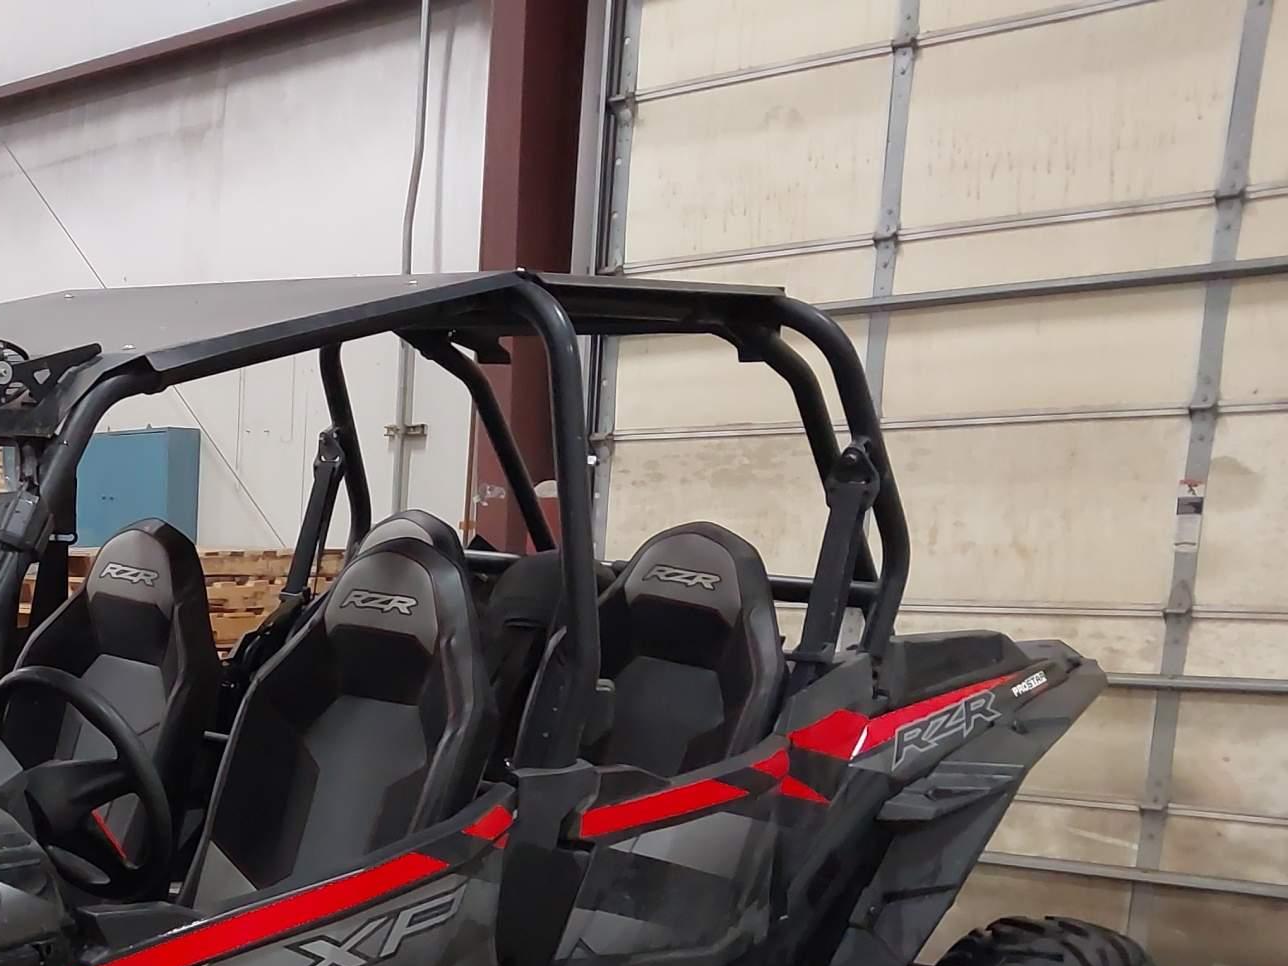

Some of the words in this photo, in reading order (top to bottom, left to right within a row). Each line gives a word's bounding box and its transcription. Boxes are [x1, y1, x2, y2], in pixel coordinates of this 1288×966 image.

[99, 562, 160, 587] RZR
[640, 564, 722, 591] RZR
[339, 589, 418, 615] RZR
[892, 690, 1002, 772] RZR
